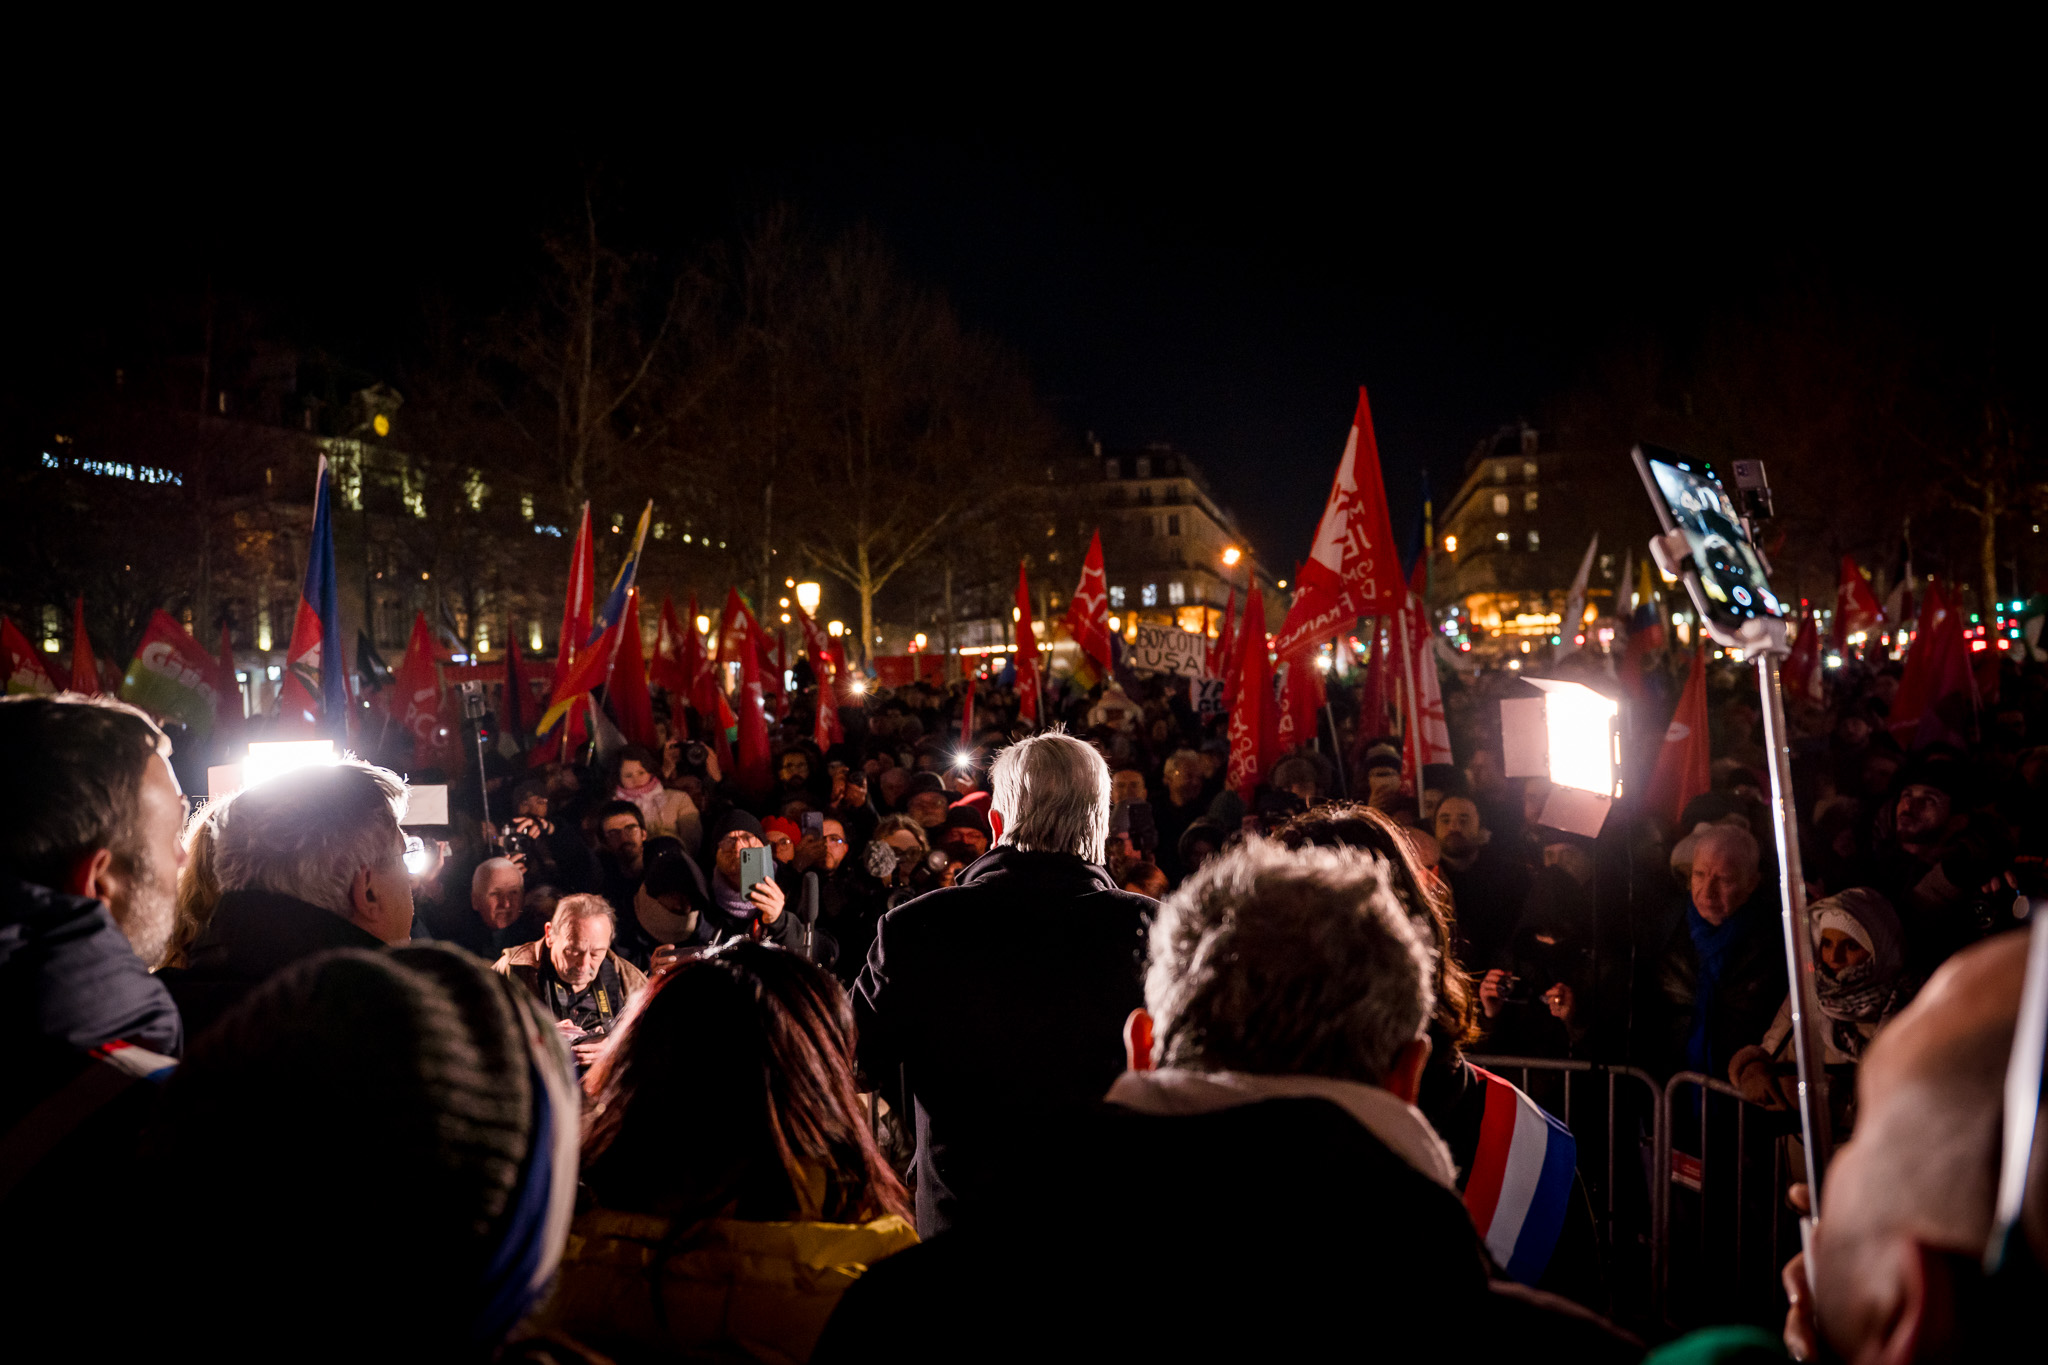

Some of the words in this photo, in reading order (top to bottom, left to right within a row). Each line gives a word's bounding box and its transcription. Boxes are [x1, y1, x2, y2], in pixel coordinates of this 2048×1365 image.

[1139, 627, 1202, 656] BOYCOTT
[1144, 650, 1201, 675] USA
[597, 989, 609, 1013] Nikon
